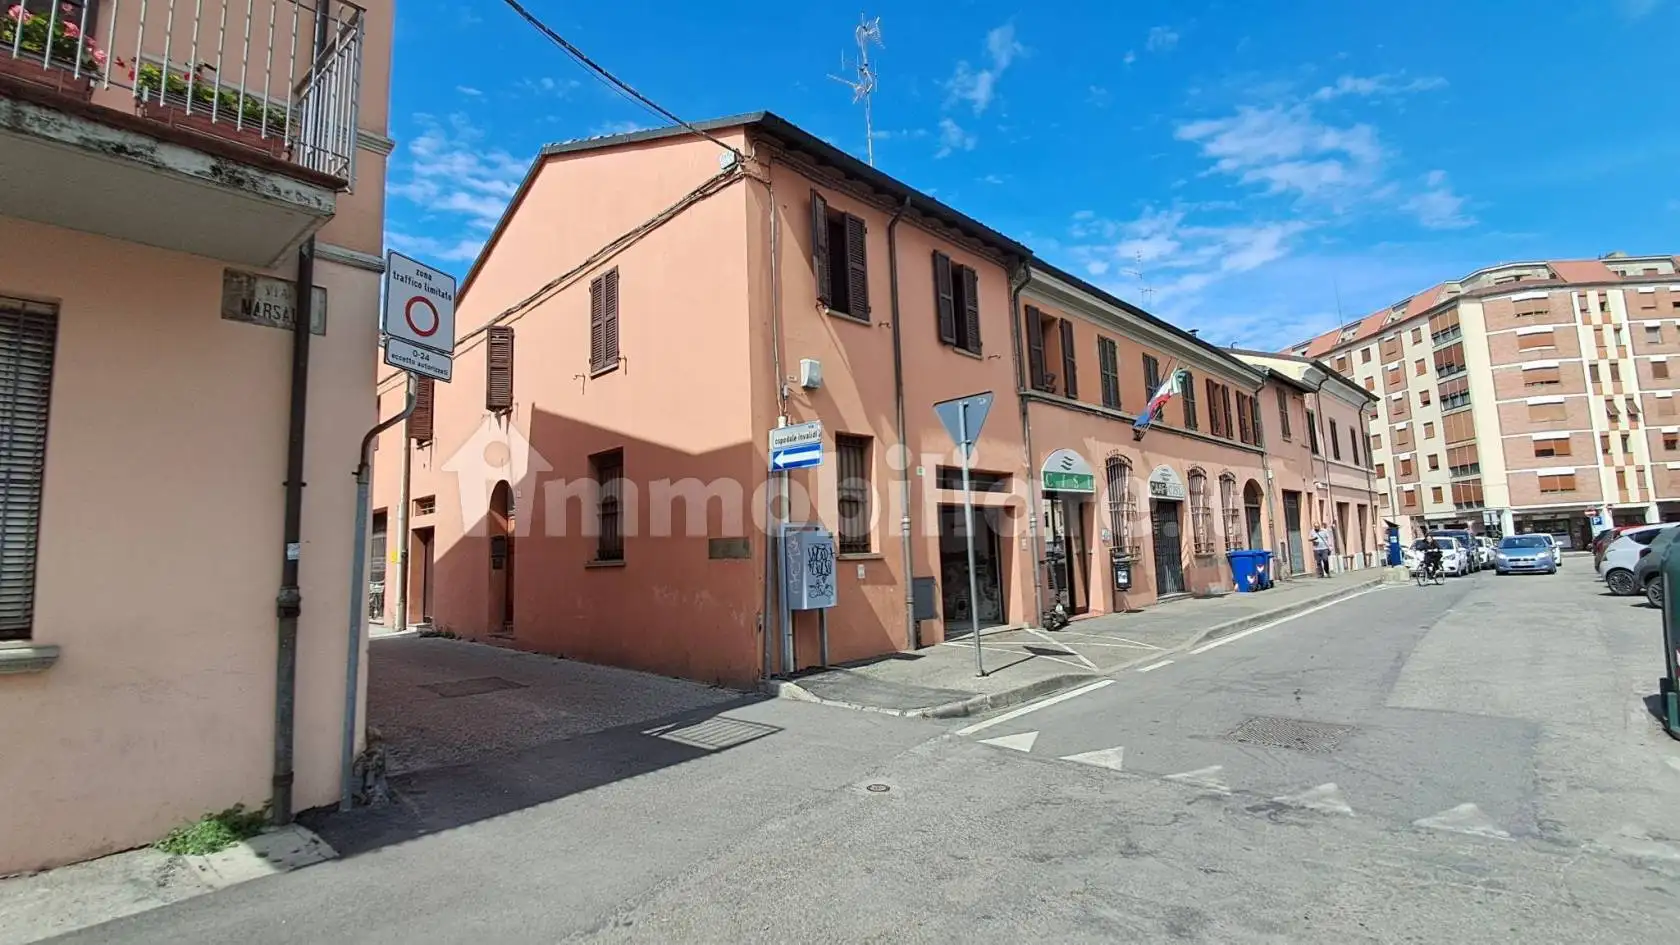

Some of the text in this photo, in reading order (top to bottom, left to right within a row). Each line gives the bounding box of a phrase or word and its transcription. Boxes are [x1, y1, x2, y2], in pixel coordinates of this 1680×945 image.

[416, 269, 432, 281] zona
[393, 270, 452, 301] traffico limitato
[412, 350, 430, 361] 0-24
